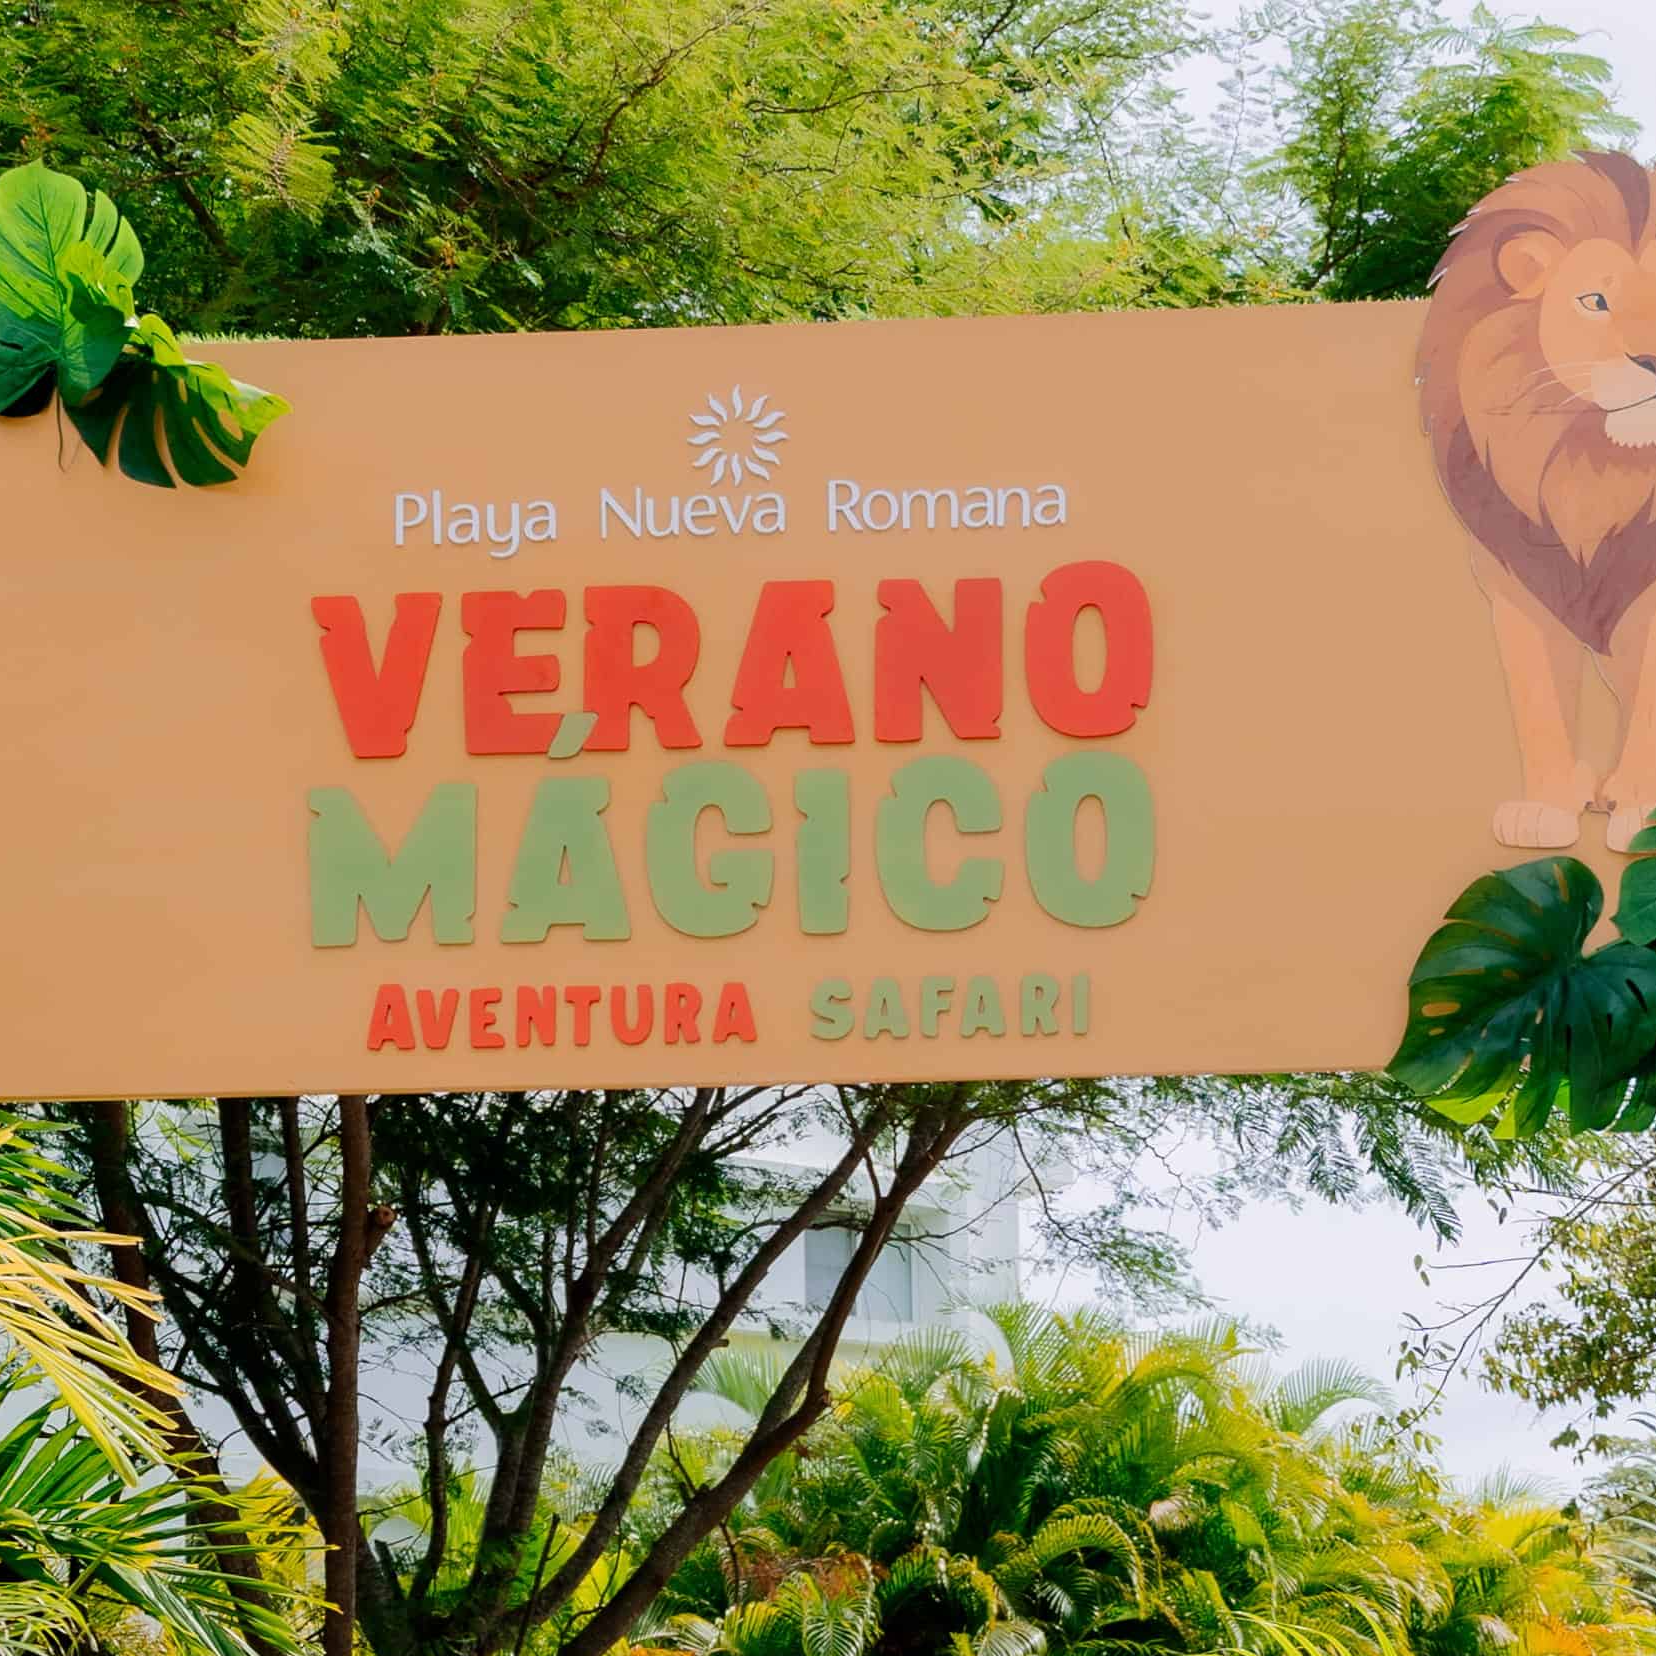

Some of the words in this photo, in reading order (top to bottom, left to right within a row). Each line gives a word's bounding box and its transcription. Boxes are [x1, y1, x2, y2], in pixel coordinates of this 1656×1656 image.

[393, 490, 558, 559] Playa
[600, 485, 786, 539] Nueva
[827, 479, 1069, 535] Romana
[310, 559, 1155, 760] VERANO
[307, 711, 1157, 948] MÁGICO
[366, 982, 759, 1050] AVENTURA
[809, 972, 1091, 1041] SAFARI
